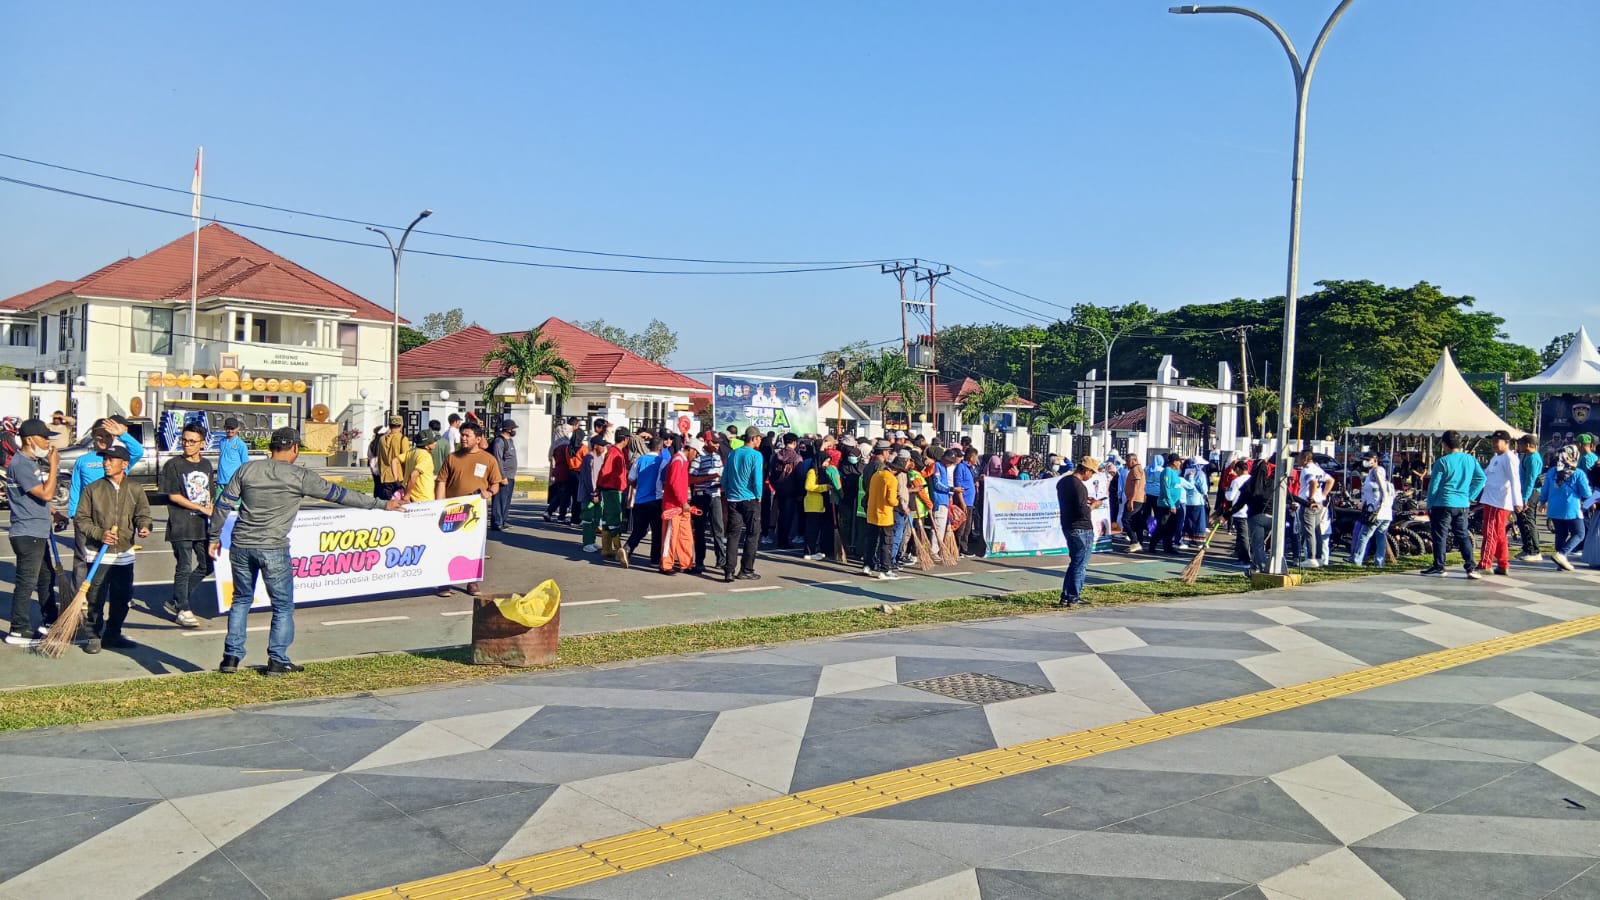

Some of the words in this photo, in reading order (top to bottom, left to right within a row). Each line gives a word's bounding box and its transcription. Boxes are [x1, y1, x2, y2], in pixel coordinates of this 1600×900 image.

[239, 430, 273, 439] KONAW
[443, 511, 468, 522] CLEANUP
[445, 504, 466, 515] WORLD
[320, 527, 395, 553] WORLD
[385, 545, 426, 568] DAY
[294, 579, 322, 590] enuju
[324, 575, 369, 587] Indonesia
[372, 570, 399, 581] Bersih
[401, 568, 423, 577] 2029
